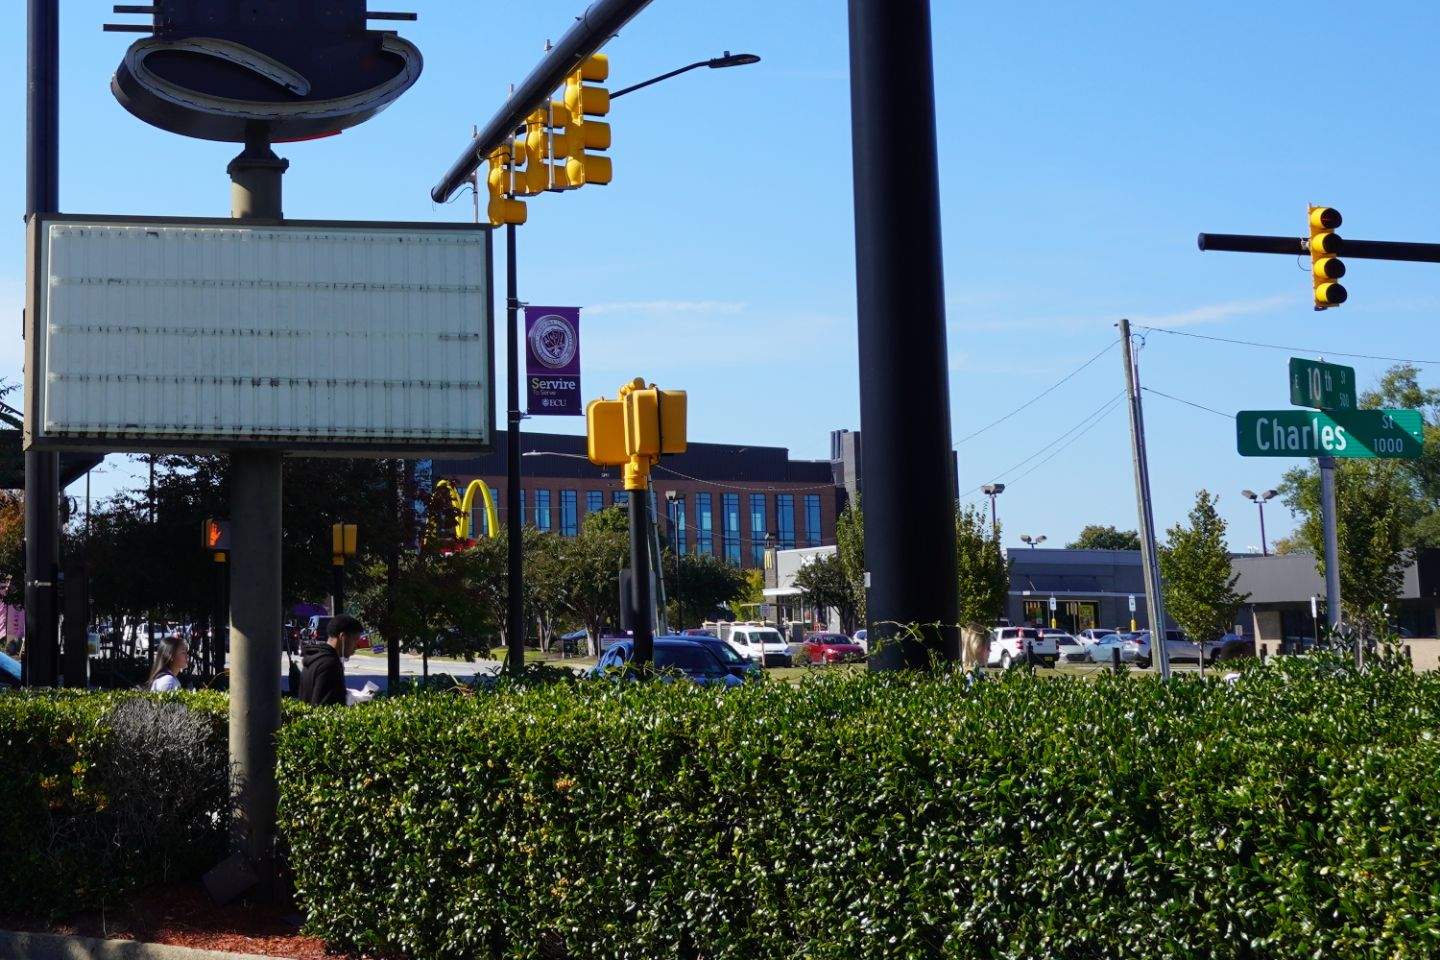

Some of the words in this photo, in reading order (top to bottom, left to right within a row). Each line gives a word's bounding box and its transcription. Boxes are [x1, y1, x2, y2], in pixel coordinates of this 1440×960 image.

[531, 377, 576, 390] Servire
[1307, 367, 1321, 401] 10
[1324, 370, 1333, 393] th
[1256, 417, 1347, 451] Charles
[1382, 414, 1394, 430] St
[1374, 437, 1404, 454] 1000
